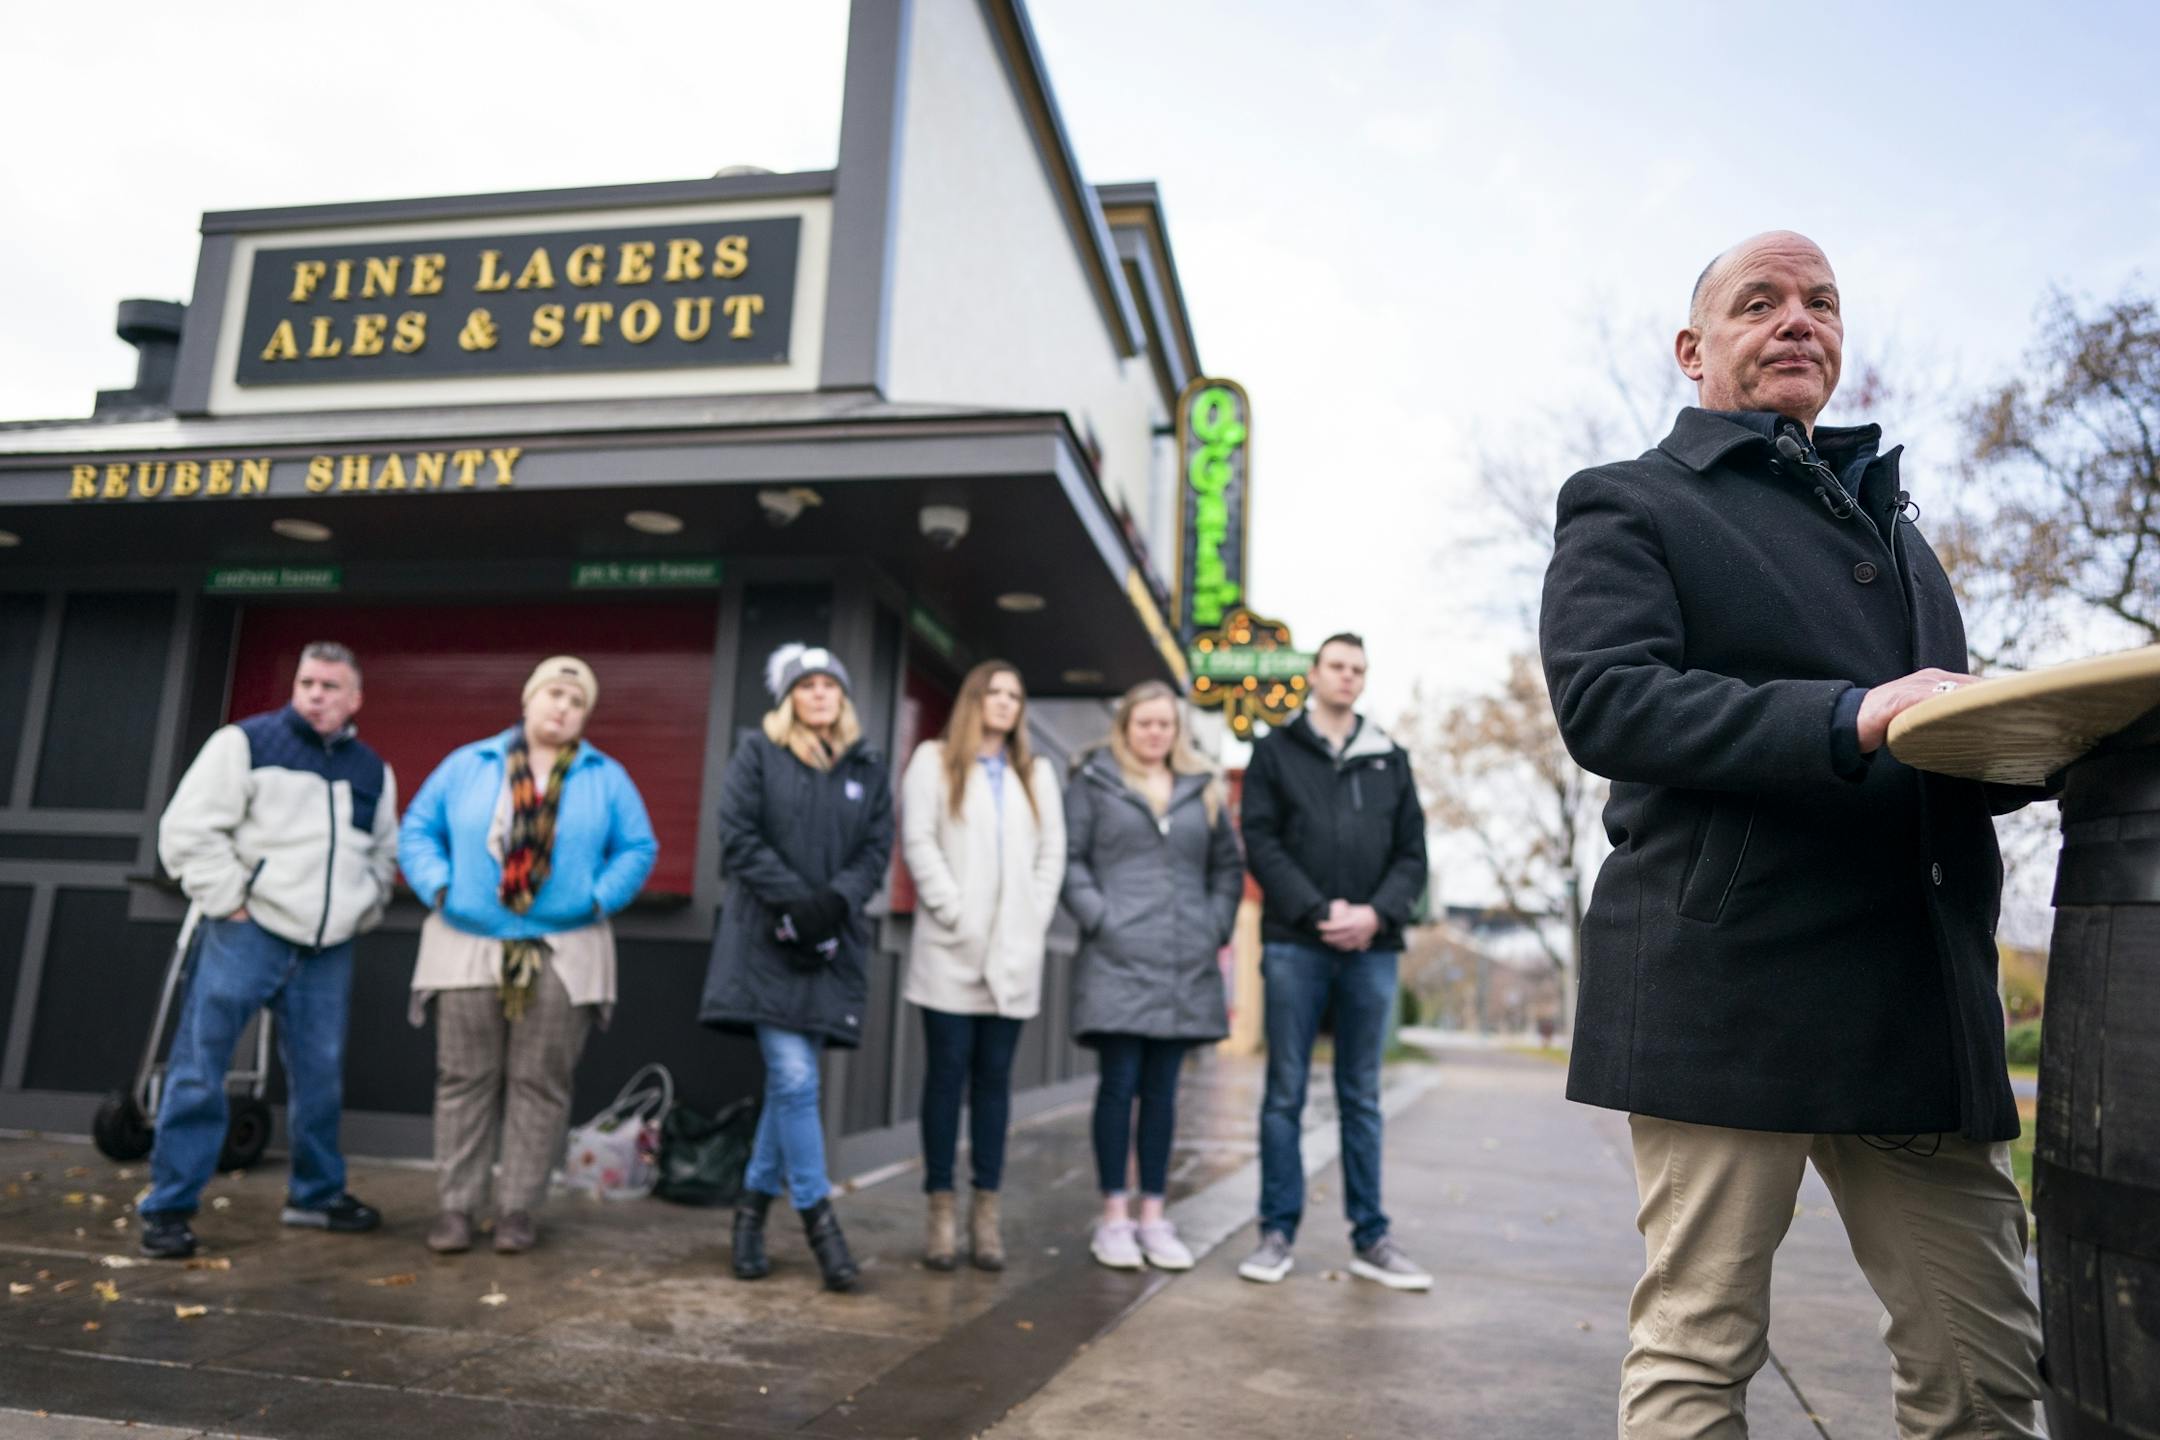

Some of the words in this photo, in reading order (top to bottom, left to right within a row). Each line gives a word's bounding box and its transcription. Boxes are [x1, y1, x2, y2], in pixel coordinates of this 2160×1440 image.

[290, 253, 446, 303] FINE
[474, 234, 750, 292] LAGERS
[260, 311, 428, 361] ALES
[458, 308, 499, 351] &
[530, 294, 764, 348] STOUT
[69, 458, 272, 499] REUBEN
[304, 447, 523, 493] SHANTY
